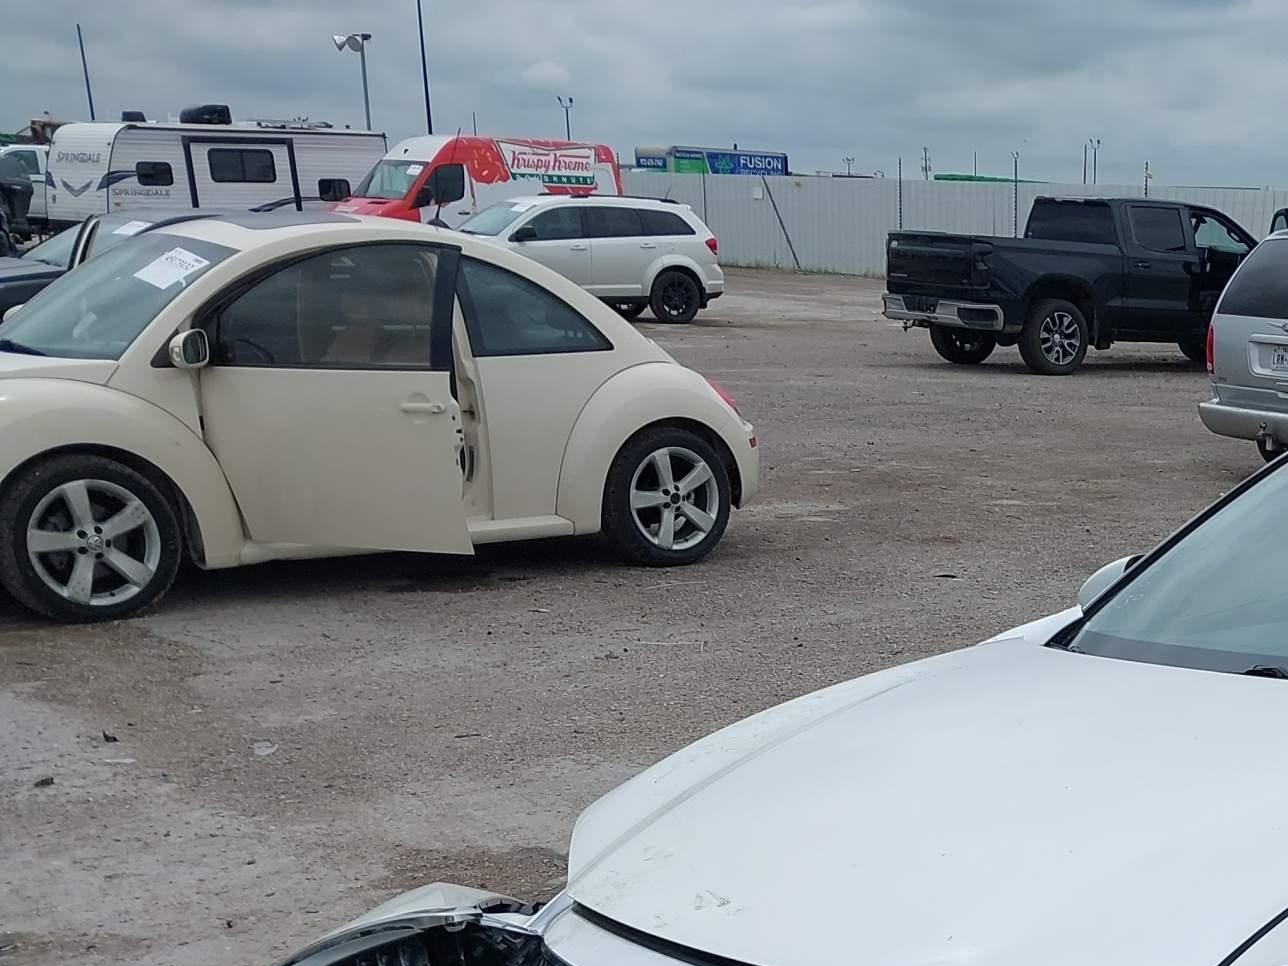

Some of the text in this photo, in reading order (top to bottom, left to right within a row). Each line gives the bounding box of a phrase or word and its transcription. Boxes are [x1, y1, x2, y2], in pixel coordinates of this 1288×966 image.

[56, 151, 101, 163] SPRINGDALE
[511, 150, 592, 173] Krispy Kreme
[740, 156, 782, 170] FUSION
[515, 174, 594, 184] DOUGHNUTS
[112, 188, 170, 197] SPRINGDALE
